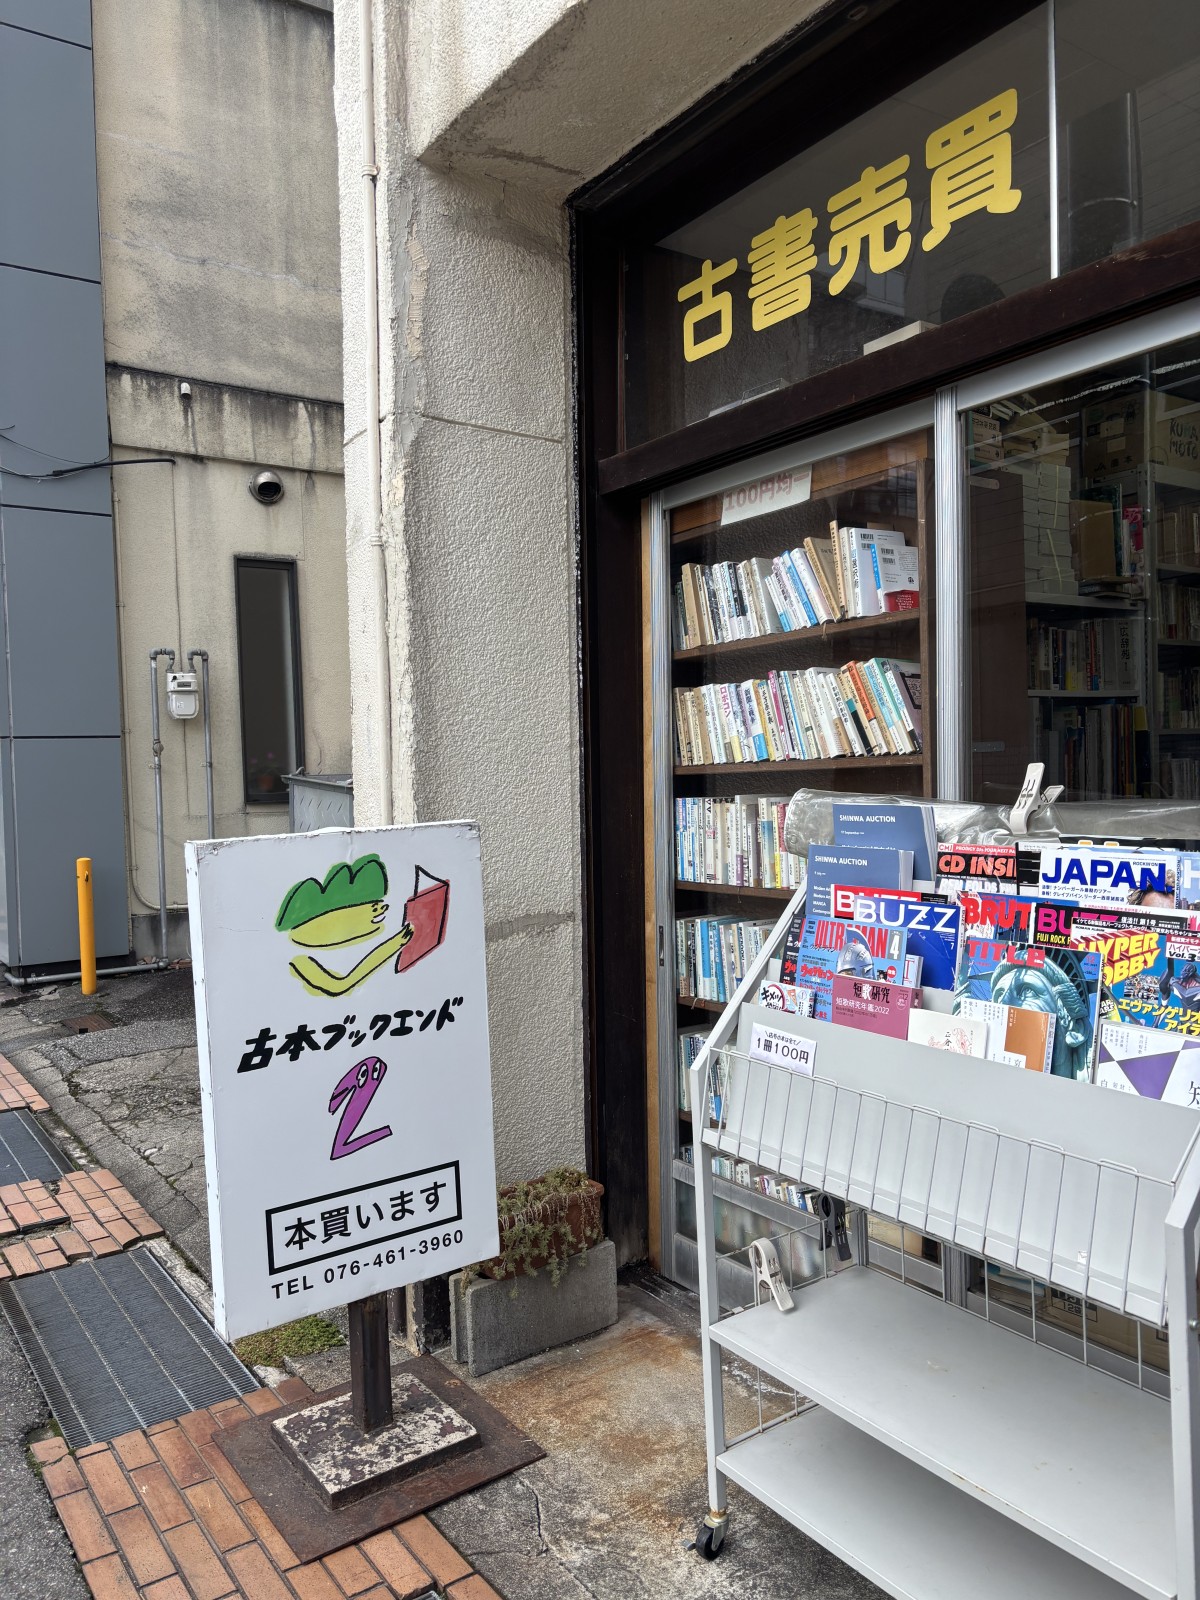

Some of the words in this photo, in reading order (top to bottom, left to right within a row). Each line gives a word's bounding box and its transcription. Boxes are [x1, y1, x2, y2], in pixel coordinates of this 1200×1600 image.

[677, 88, 1022, 362] 古書売買
[724, 471, 810, 512] 100円均一
[839, 814, 864, 822] SHINWA
[814, 855, 838, 863] SHINWA
[838, 857, 868, 866] AUCTION
[938, 854, 966, 873] CD
[1041, 857, 1167, 893] JAPAN
[856, 899, 957, 934] BUZZ
[889, 934, 900, 960] 4
[968, 940, 1046, 968] TITLE
[1036, 933, 1050, 941] FUJI
[1050, 934, 1066, 945] ROCK
[853, 982, 890, 1004] 短歌研究
[237, 997, 464, 1073] 古本ブックエンド
[757, 1037, 809, 1064] 1冊100円
[328, 1056, 393, 1160] 2
[284, 1181, 447, 1250] 本買います
[271, 1275, 314, 1299] TEL
[324, 1229, 464, 1284] 076-461-3960
